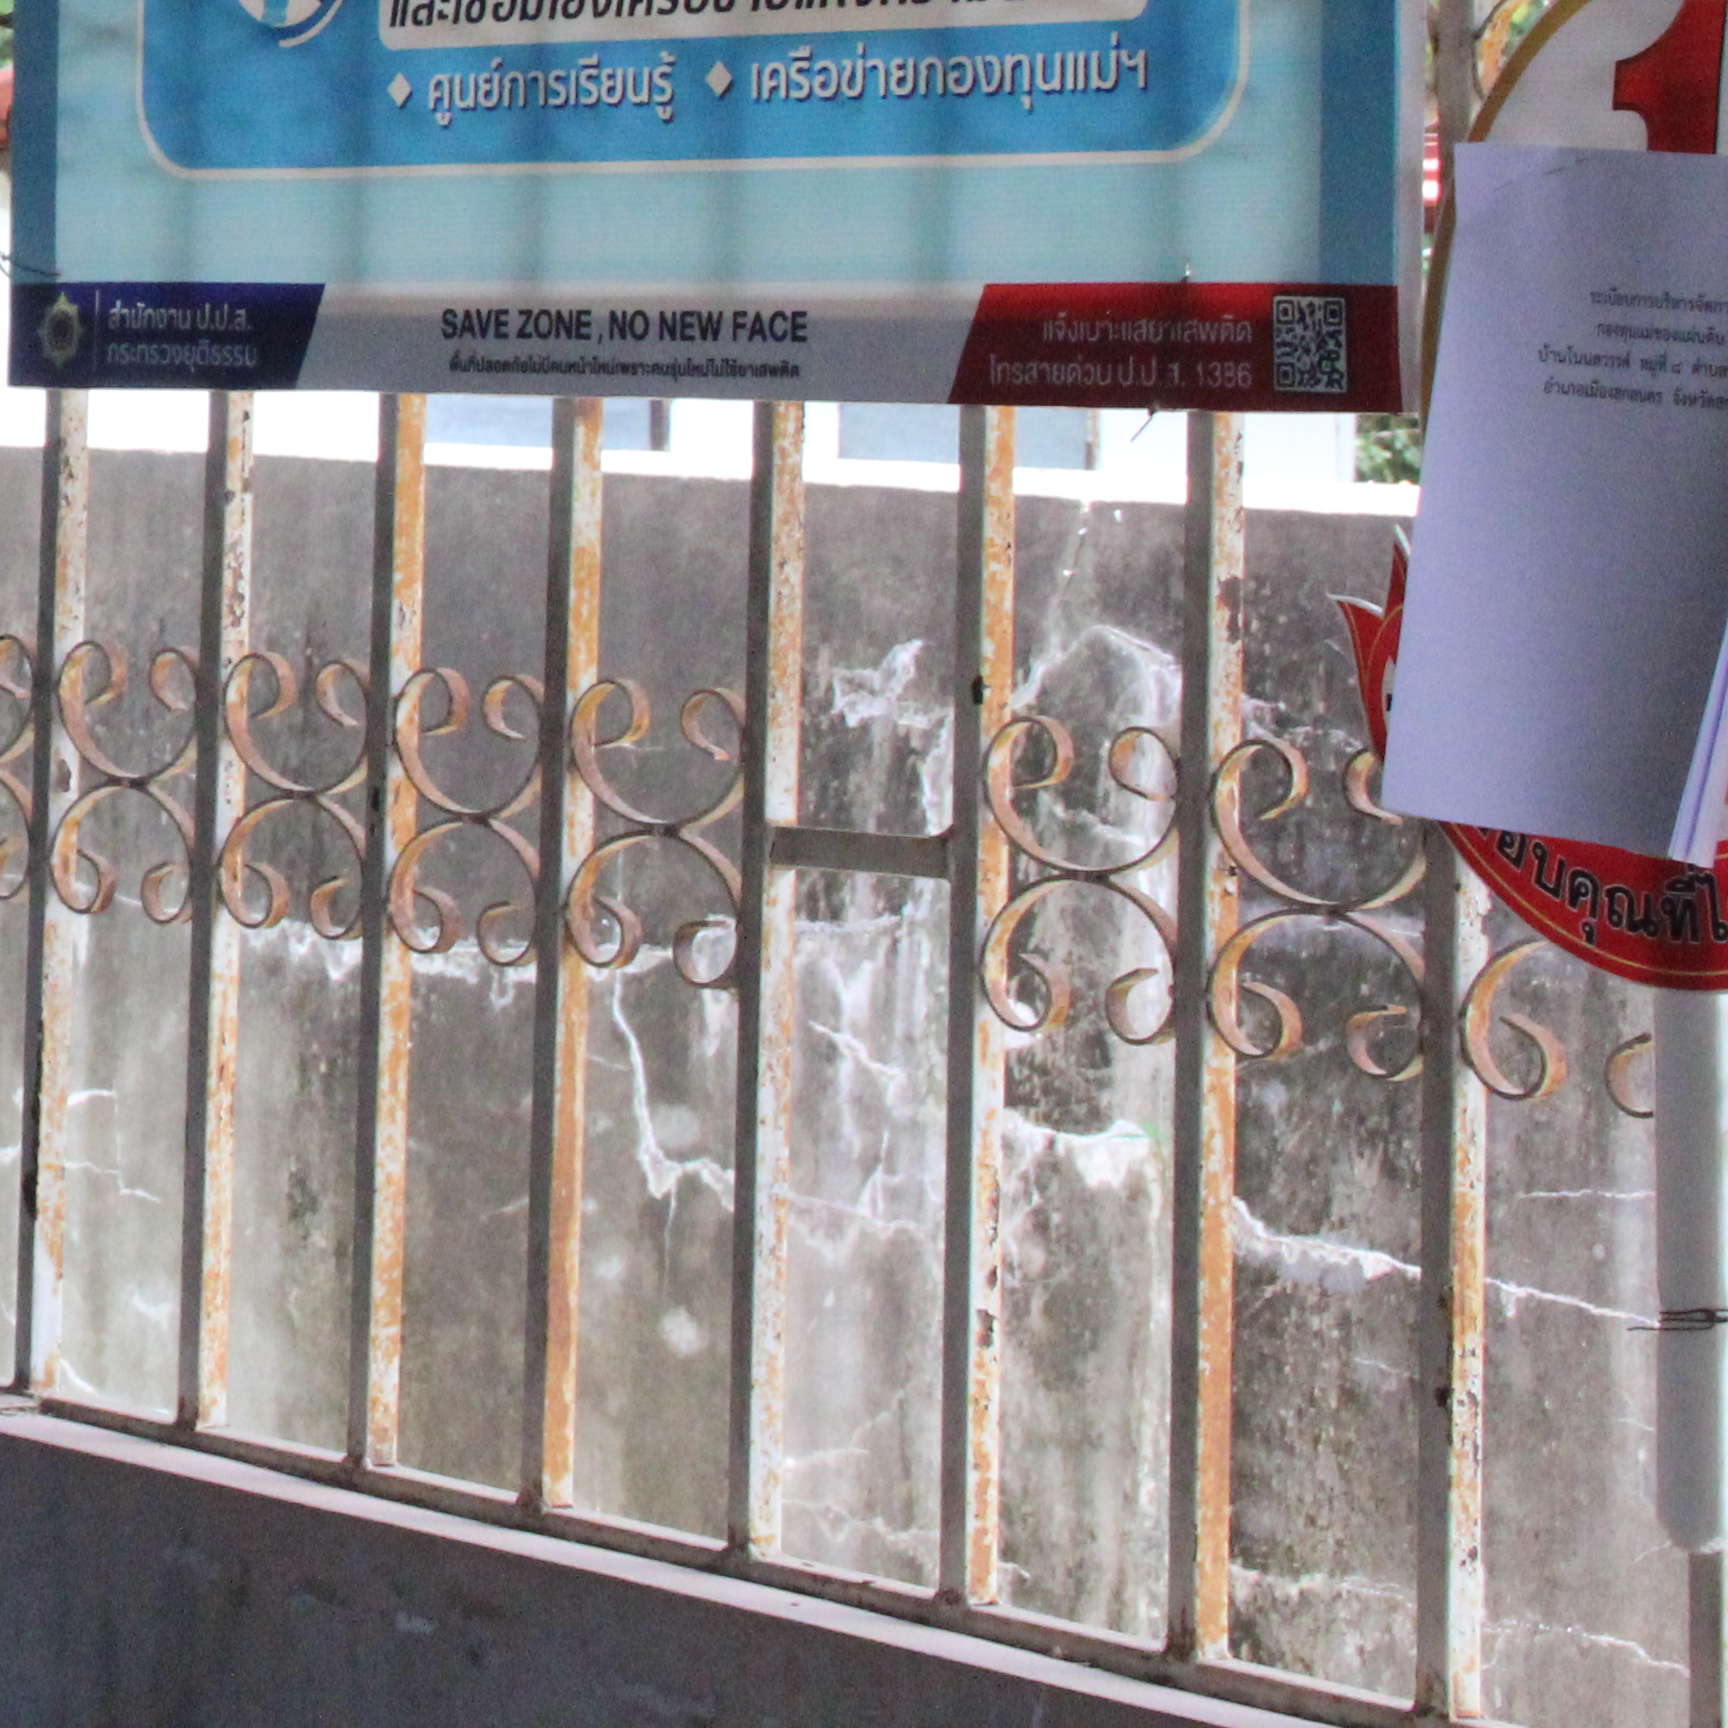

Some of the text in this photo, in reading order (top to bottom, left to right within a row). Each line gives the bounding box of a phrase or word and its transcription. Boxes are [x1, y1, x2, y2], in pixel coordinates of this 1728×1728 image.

[427, 34, 1147, 126] ศูนย์การเรียนรู้ เครือข่ายกองทุนแม่ฯ
[442, 308, 510, 340] SAVE
[608, 310, 650, 342] NO
[658, 310, 723, 343] NEW
[732, 310, 808, 344] FACE
[1196, 360, 1252, 388] 1386
